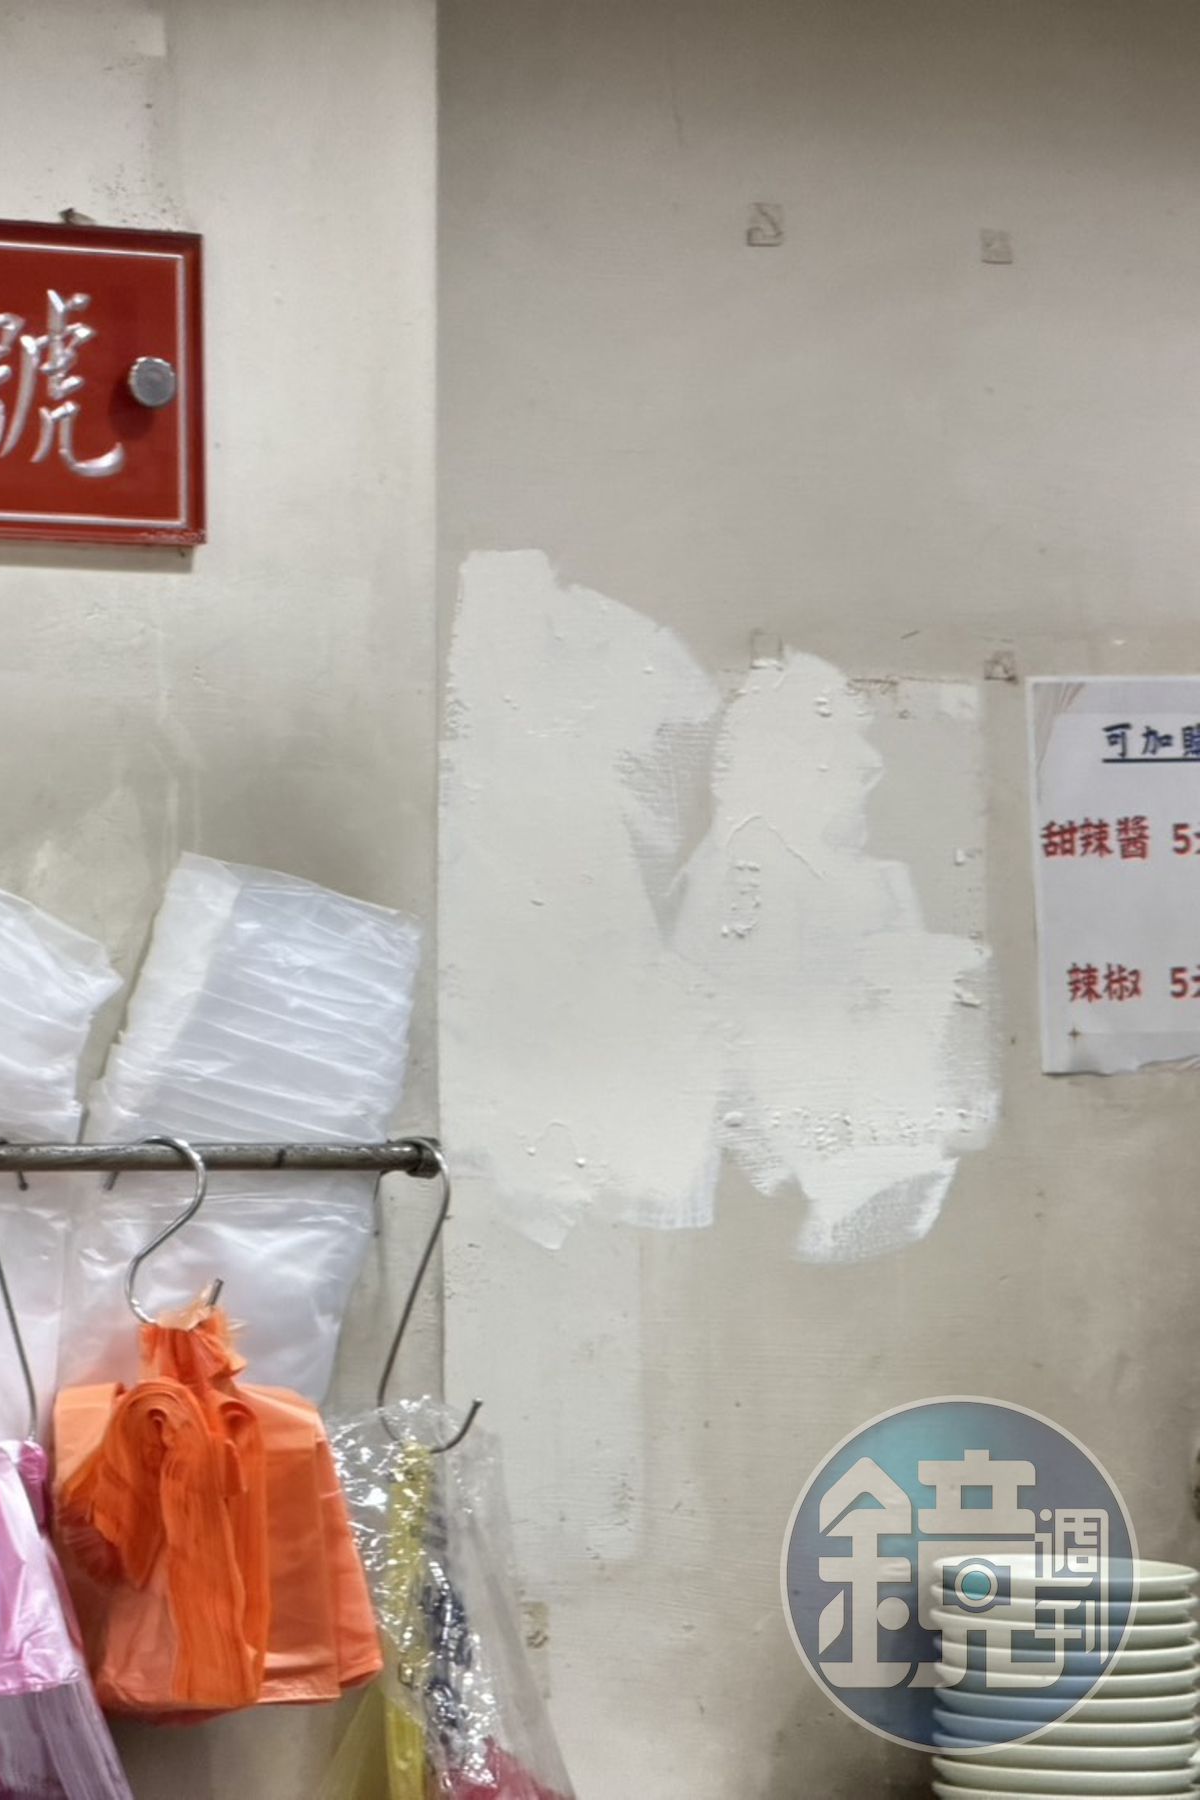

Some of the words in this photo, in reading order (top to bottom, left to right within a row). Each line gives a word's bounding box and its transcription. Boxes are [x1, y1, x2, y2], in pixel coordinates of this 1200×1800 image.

[1040, 815, 1150, 860] 甜辣醬
[1066, 962, 1143, 1002] 辣椒
